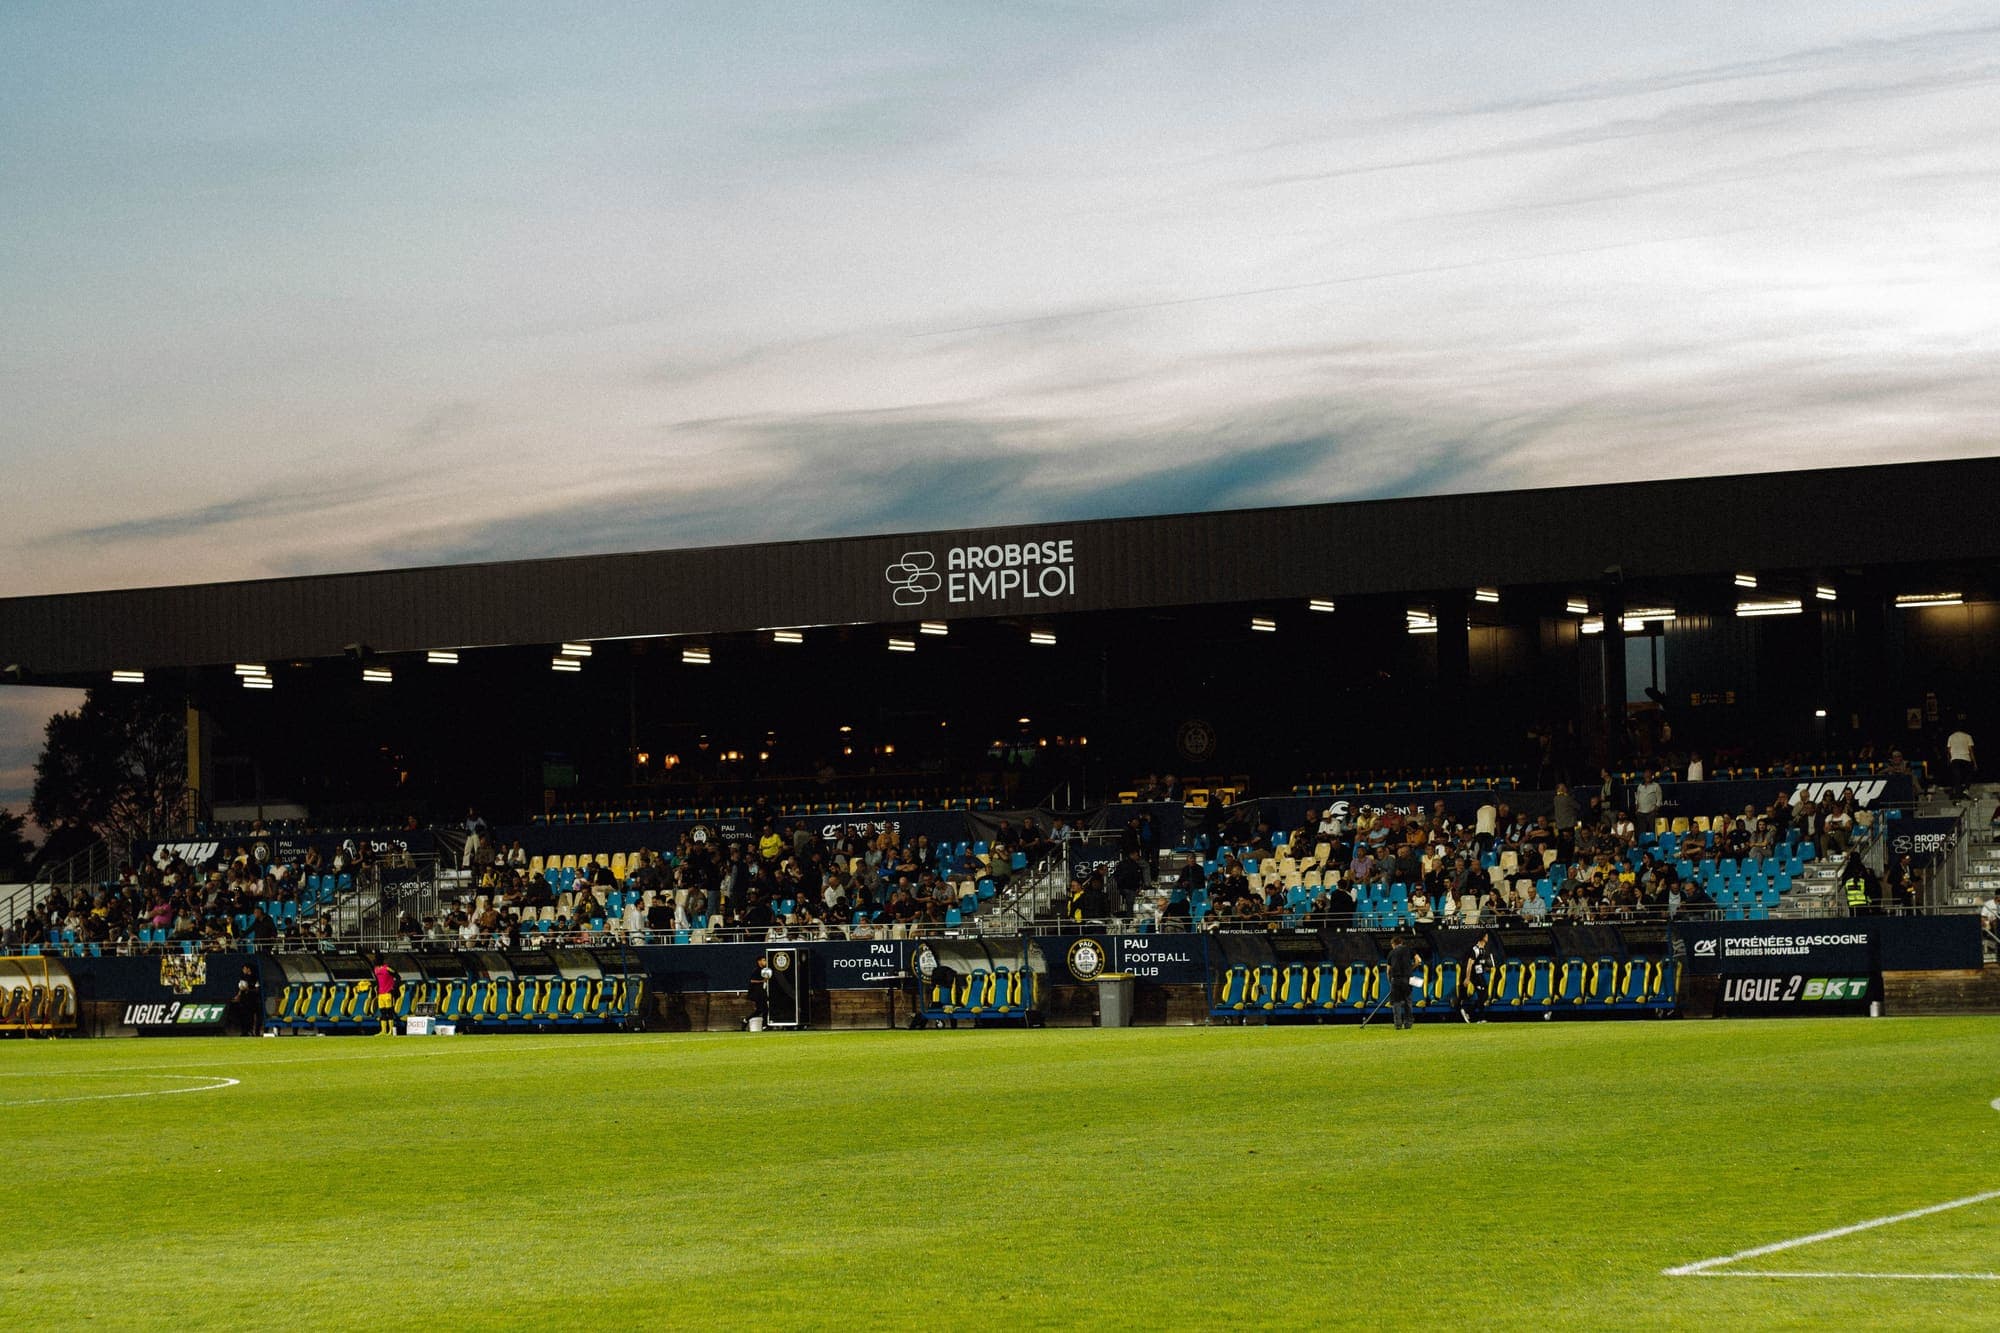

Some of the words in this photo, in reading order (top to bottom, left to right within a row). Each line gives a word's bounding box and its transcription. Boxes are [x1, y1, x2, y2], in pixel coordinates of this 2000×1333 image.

[948, 540, 1073, 570] AROBASE
[949, 566, 1074, 602] EMPLOI
[1123, 939, 1149, 949] PAU
[1725, 935, 1795, 947] PYRÉNÉES
[1796, 934, 1868, 946] GASCOGNE
[870, 944, 894, 954] PAU
[1764, 946, 1810, 956] NOUVELLES
[1124, 952, 1191, 962] FOOTBALL
[833, 958, 894, 968] FOOTBALL
[1724, 978, 1782, 1002] LIGUE
[1803, 981, 1868, 996] BKT
[123, 1004, 167, 1025] LIGUE
[180, 1007, 225, 1020] BKT
